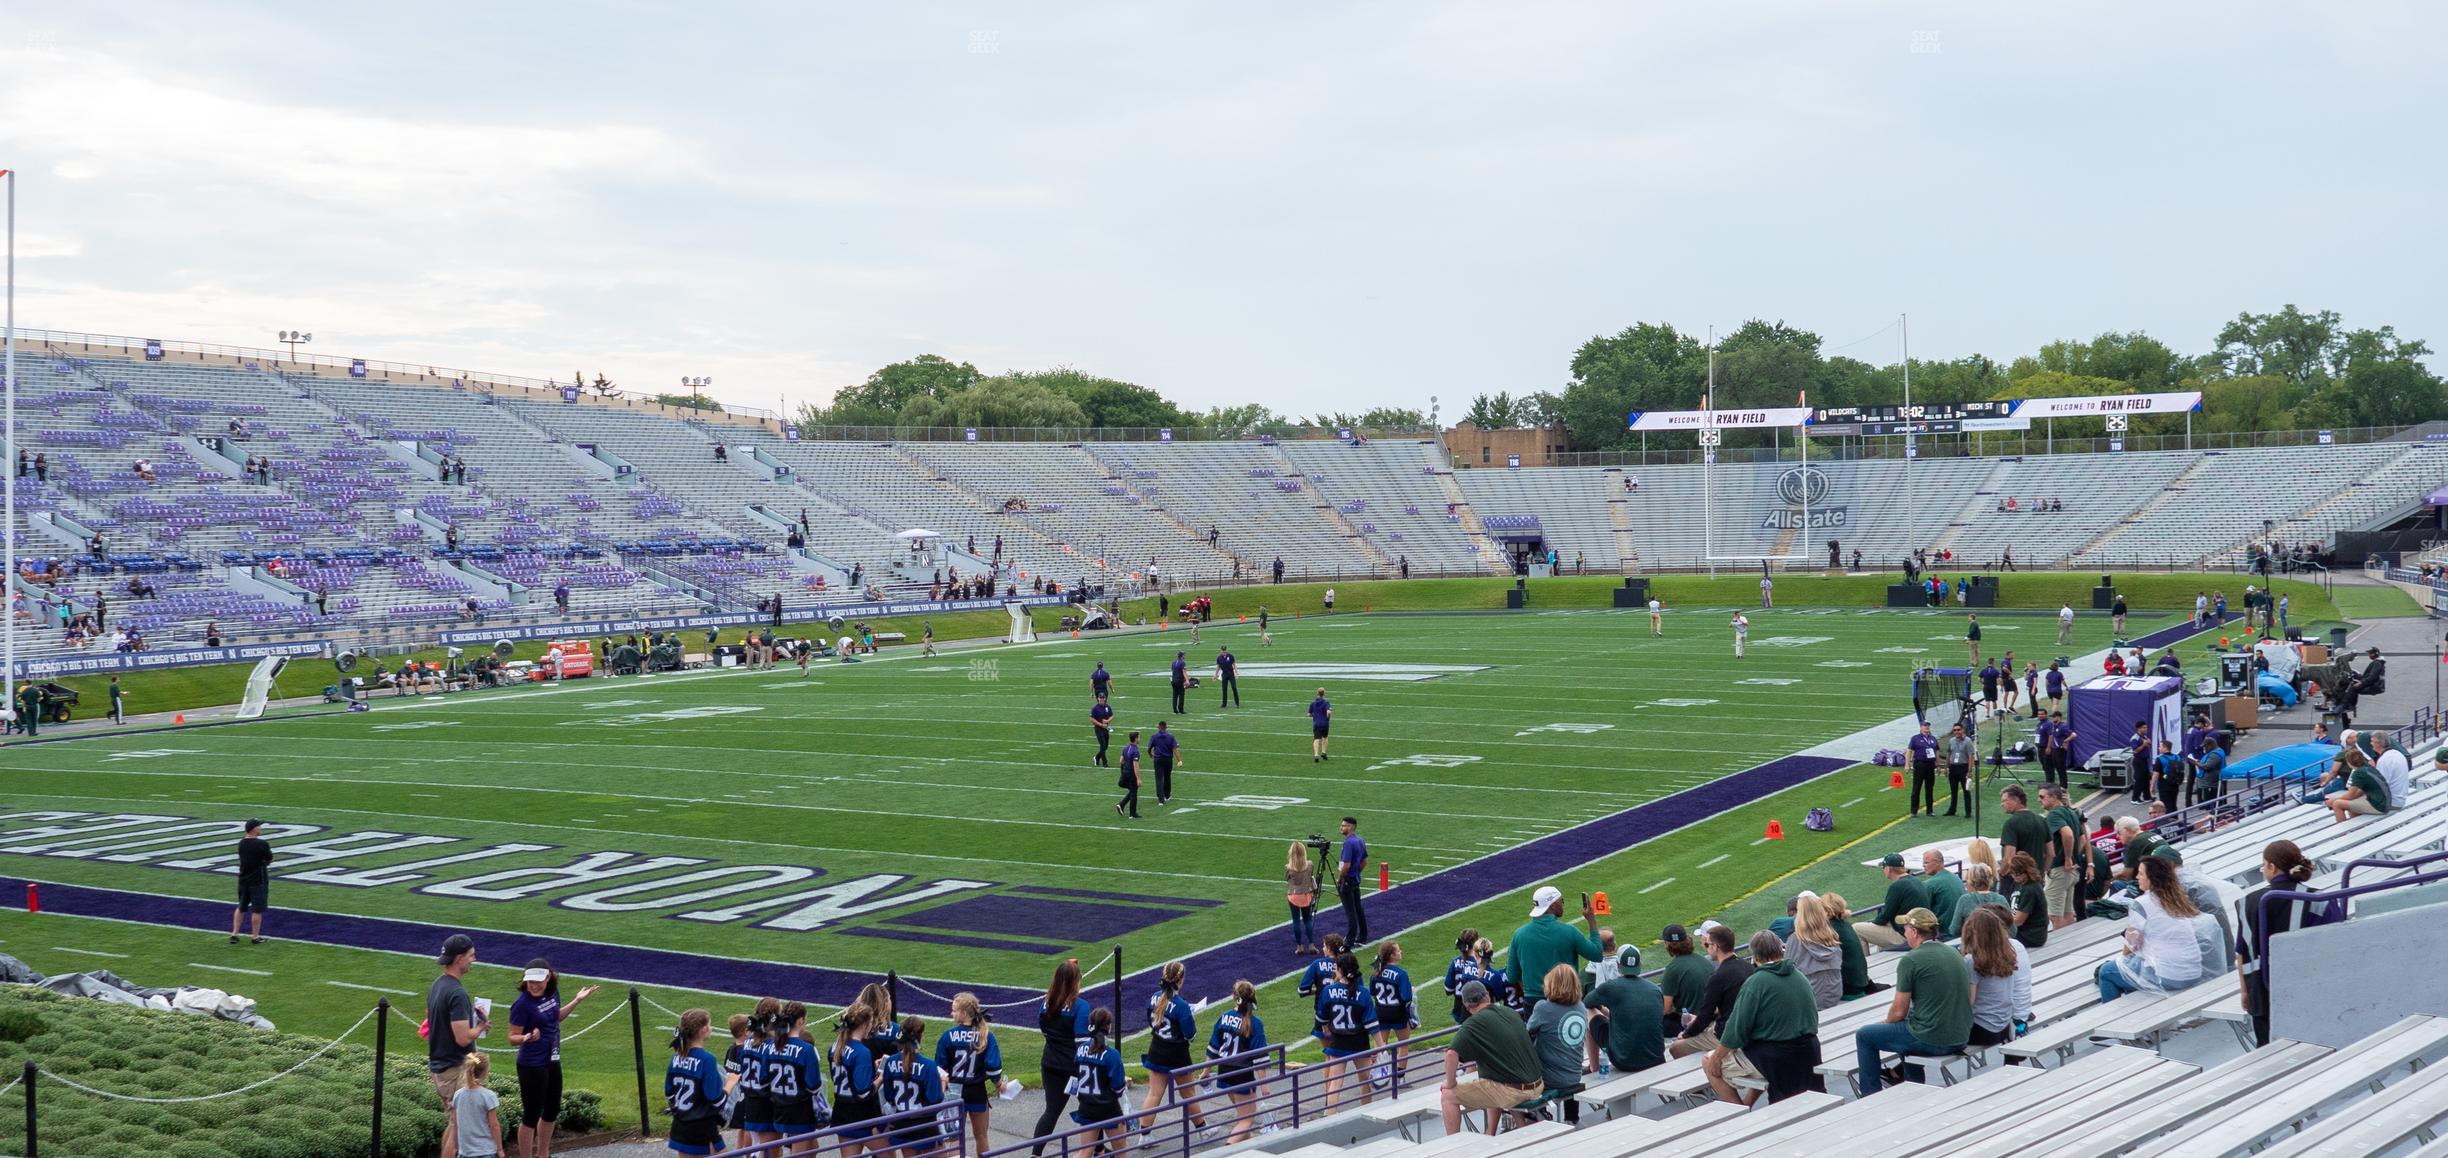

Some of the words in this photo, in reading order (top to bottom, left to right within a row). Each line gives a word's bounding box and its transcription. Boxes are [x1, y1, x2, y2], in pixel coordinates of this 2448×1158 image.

[2050, 403, 2083, 411] WELCOME
[2100, 400, 2124, 411] RYAN
[2126, 398, 2152, 410] FIELD
[1716, 414, 1739, 425] RYAN
[1741, 413, 1766, 423] FIELD
[2108, 416, 2125, 430] 25
[1763, 509, 1846, 529] Allstate
[138, 654, 175, 665] CHICAGO'S
[205, 650, 225, 660] TEAM
[1770, 826, 1779, 834] 10
[1595, 900, 1606, 911] G
[1376, 983, 1400, 1005] 22
[1332, 1004, 1356, 1030] 21
[950, 1030, 981, 1043] VARSIT
[1219, 1032, 1240, 1058] 21
[743, 1057, 762, 1090] 23
[888, 1059, 925, 1076] VARTY
[952, 1050, 977, 1078] 21
[768, 1063, 798, 1097] 23
[1078, 1064, 1102, 1095] 21
[893, 1080, 920, 1111] 22
